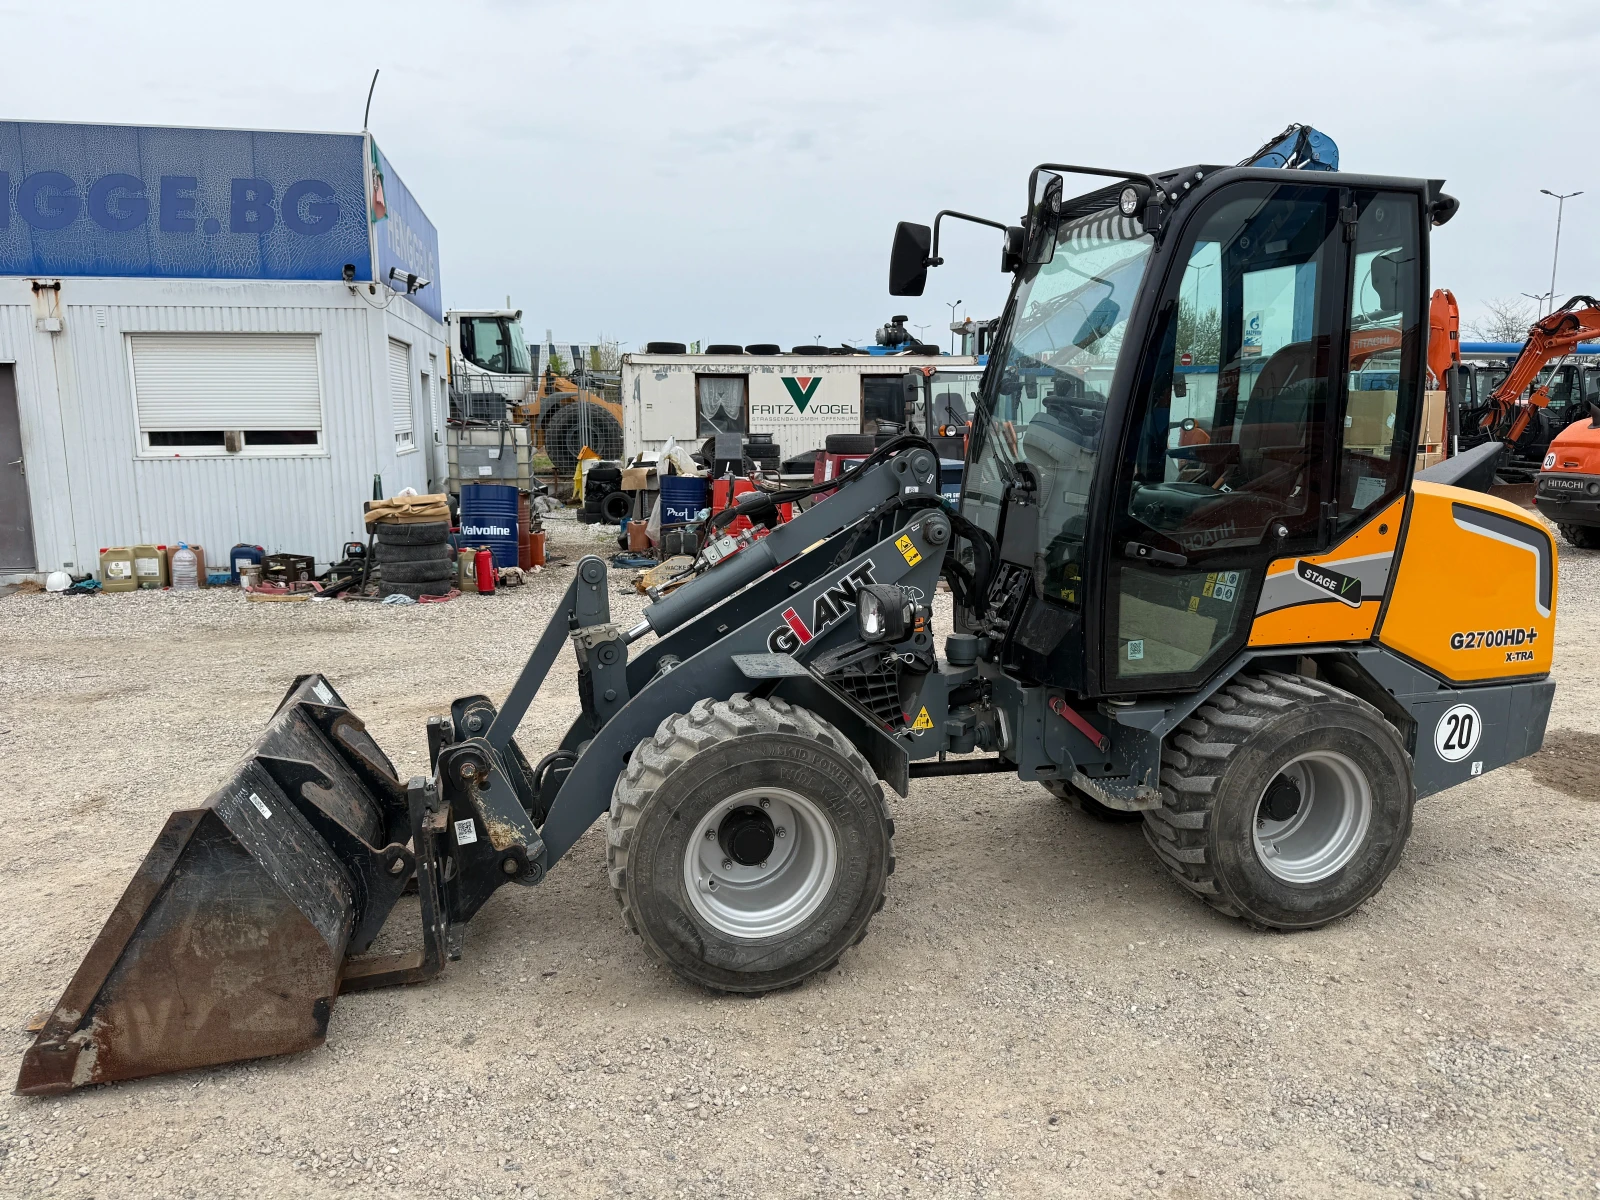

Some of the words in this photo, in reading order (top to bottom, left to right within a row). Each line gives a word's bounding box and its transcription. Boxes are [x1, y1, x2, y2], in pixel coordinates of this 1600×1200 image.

[0, 171, 340, 236] GGE.BG
[1352, 335, 1391, 350] HITACHI
[752, 405, 794, 414] FRITZ
[809, 405, 858, 414] VOGEL
[1545, 455, 1554, 466] 20
[1548, 480, 1583, 489] HITACHI
[462, 525, 510, 535] Valvoline
[1304, 569, 1337, 590] STAGE
[1340, 576, 1360, 594] V
[1450, 628, 1537, 650] G2700HD+
[1505, 651, 1534, 663] X-TRA
[1443, 714, 1474, 750] 20
